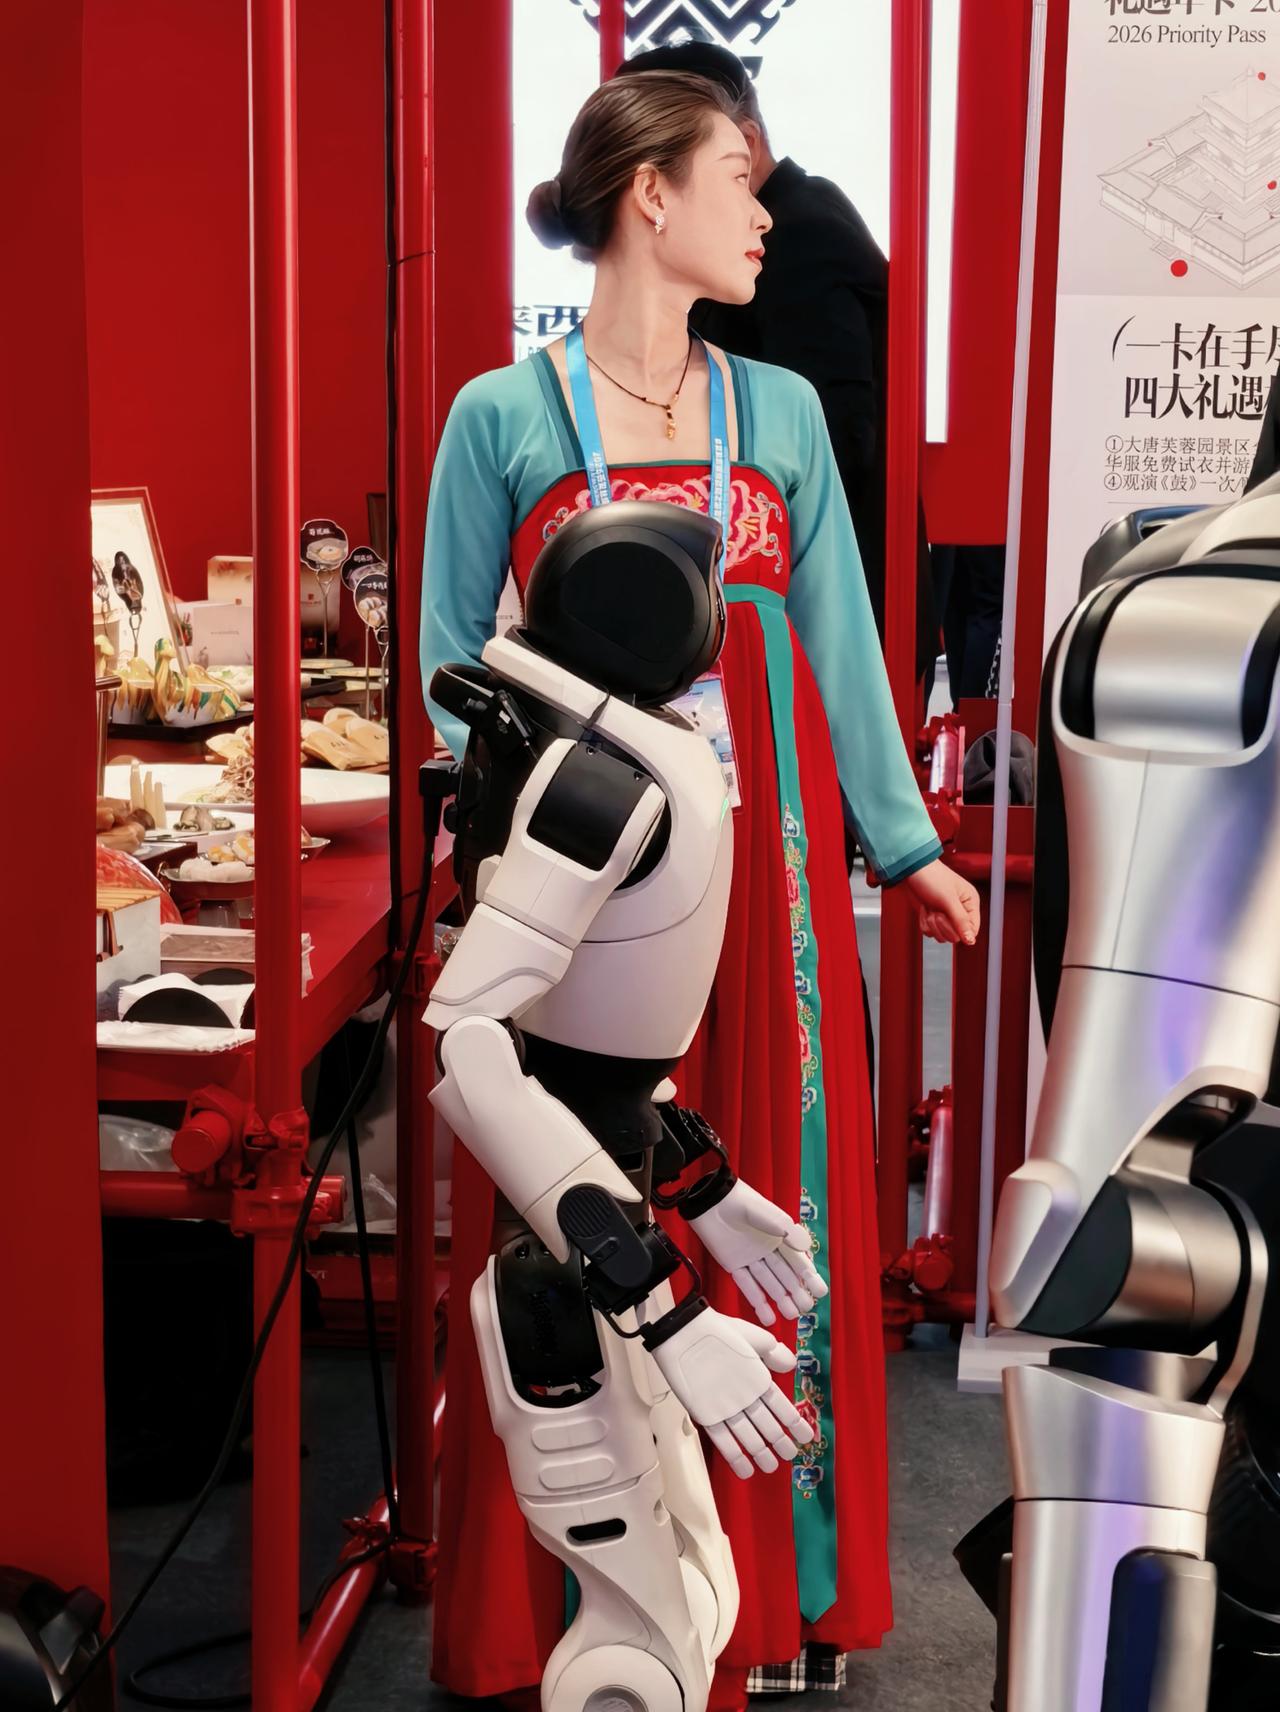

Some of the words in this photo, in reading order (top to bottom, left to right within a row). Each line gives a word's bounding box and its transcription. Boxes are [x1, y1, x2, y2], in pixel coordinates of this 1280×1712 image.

[1107, 24, 1152, 43] 2026
[1157, 24, 1223, 48] Priority
[1228, 24, 1267, 43] Pass
